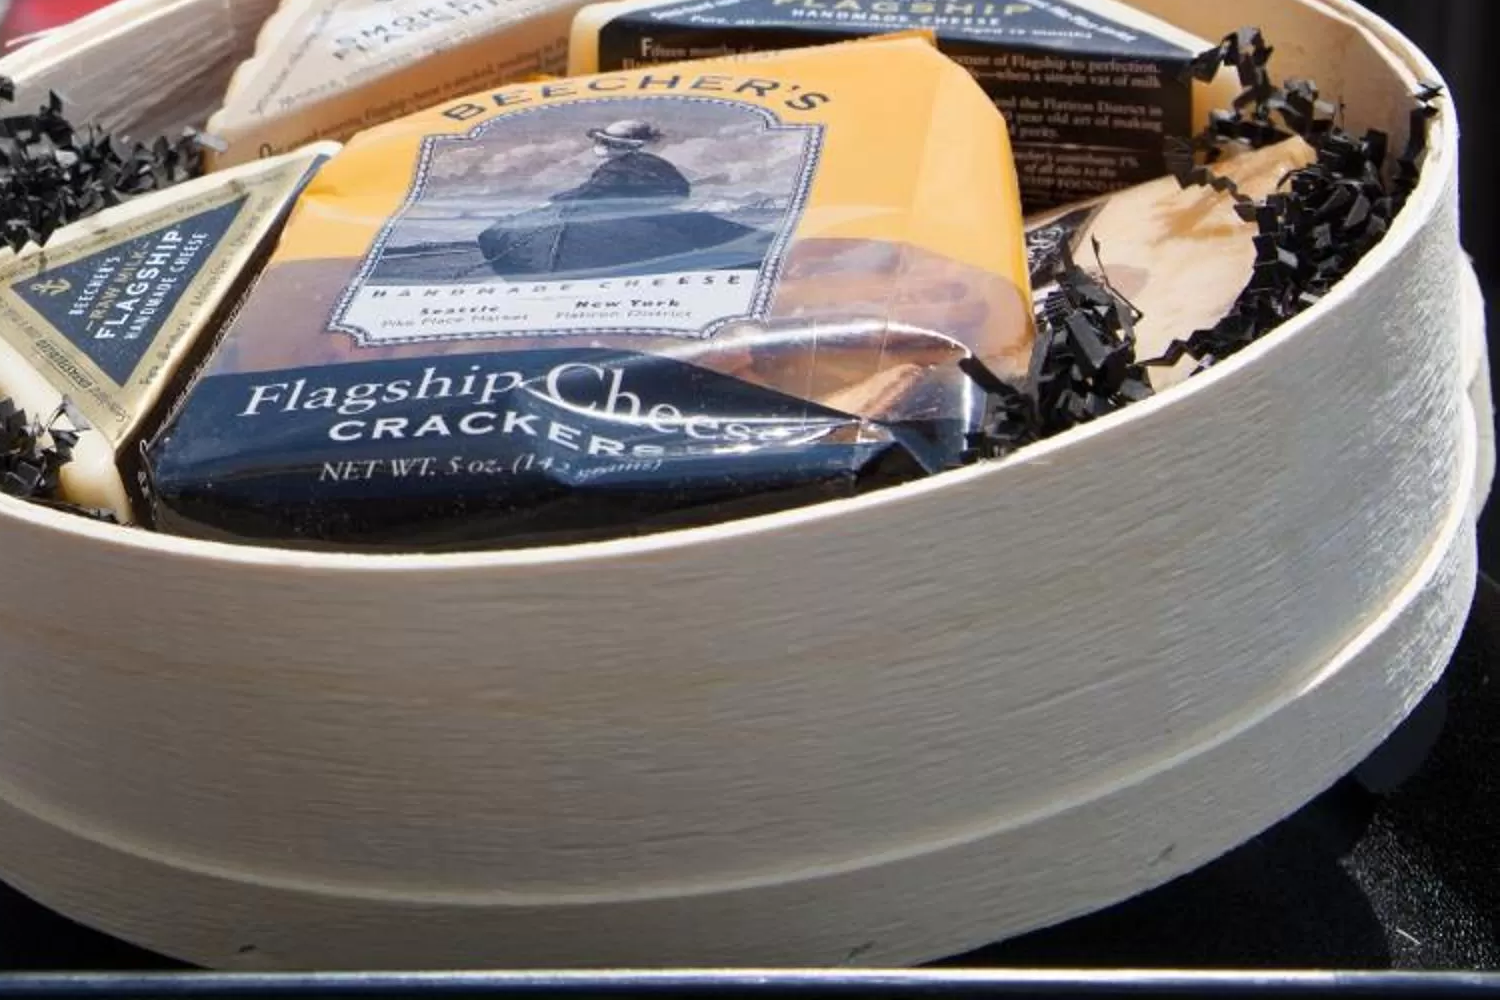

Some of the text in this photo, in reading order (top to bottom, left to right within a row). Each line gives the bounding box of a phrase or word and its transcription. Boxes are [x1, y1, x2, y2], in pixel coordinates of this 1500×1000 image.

[792, 8, 909, 23] HANDMADE
[919, 15, 1000, 26] CHEESE
[441, 74, 831, 122] BEECHER'S
[94, 230, 183, 339] FLAGSHIP
[124, 276, 178, 340] HANDMADE
[169, 231, 210, 274] CHEESE
[372, 274, 741, 299] HANDMADE CHEESE
[575, 298, 681, 310] New York
[236, 365, 524, 417] Flagship
[328, 411, 665, 458] CRACKERS
[318, 458, 384, 482] NET
[390, 456, 436, 479] WT.
[448, 455, 463, 475] 5
[466, 456, 501, 475] oz.
